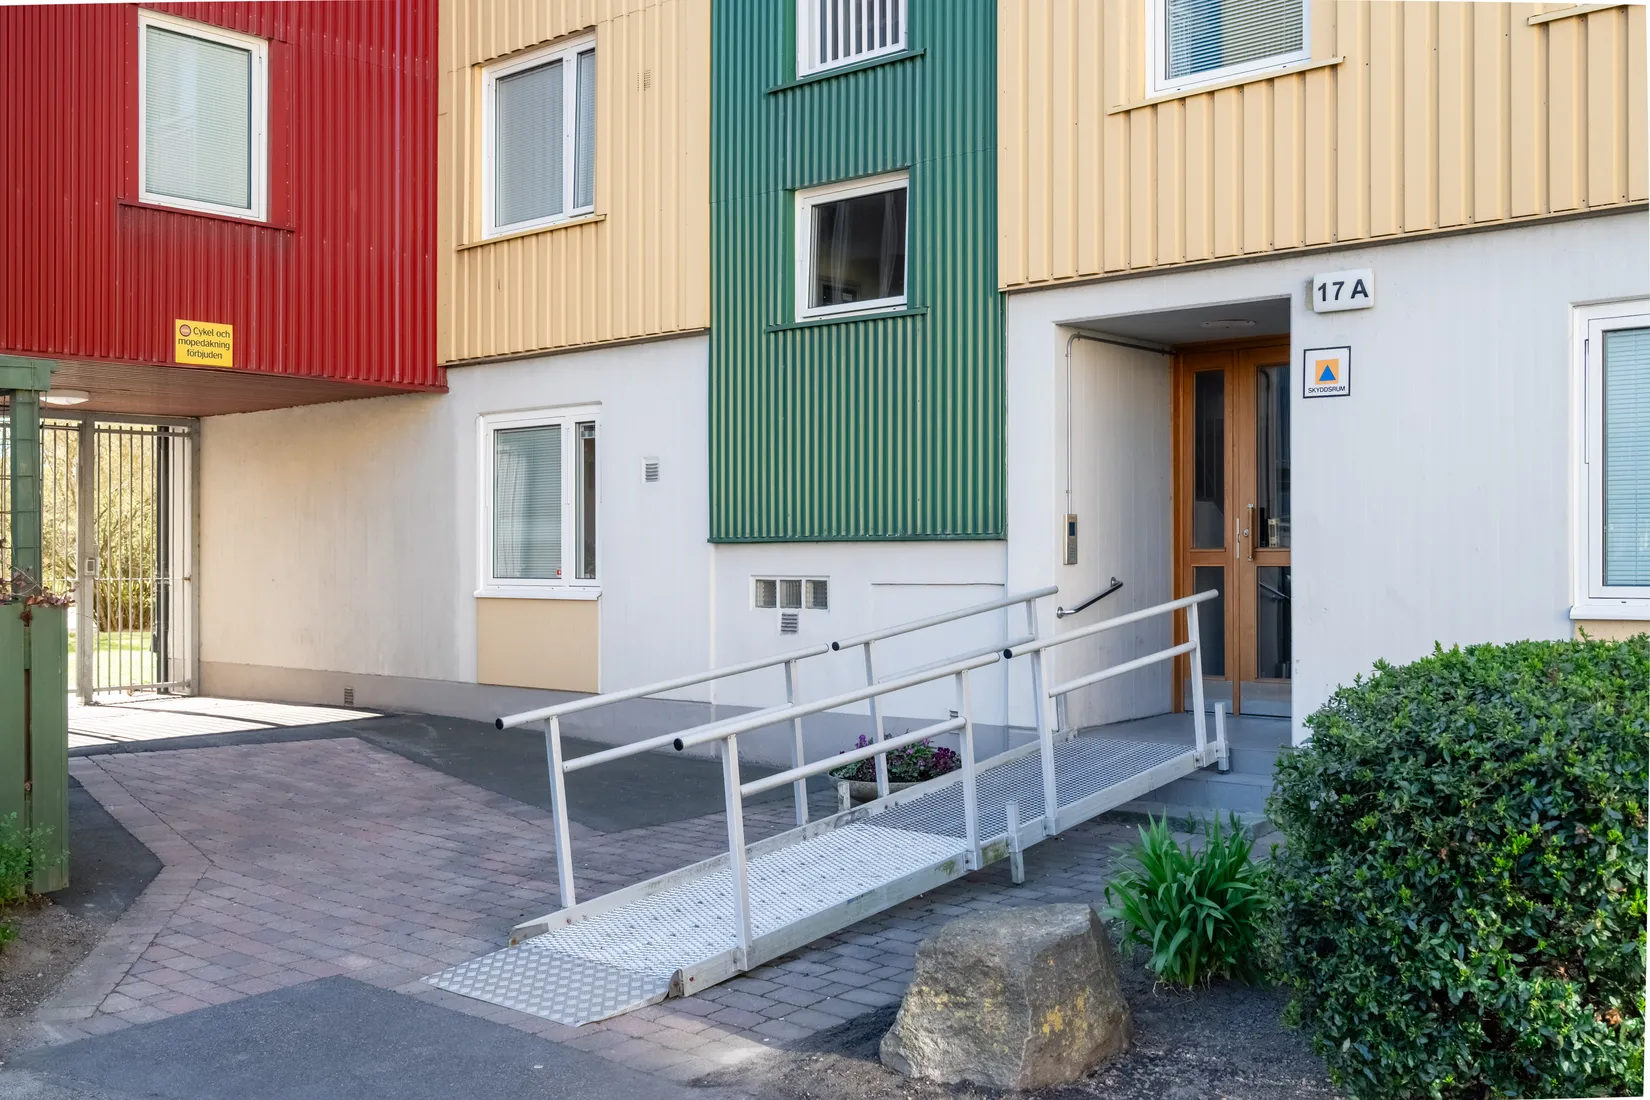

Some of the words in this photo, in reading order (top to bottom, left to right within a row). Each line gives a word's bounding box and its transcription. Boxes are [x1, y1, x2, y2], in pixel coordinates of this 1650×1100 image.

[1317, 281, 1345, 302] 17
[1350, 279, 1369, 299] A
[193, 326, 214, 337] Cykel
[216, 330, 230, 338] och
[1307, 385, 1346, 394] SKYDDSRUM
